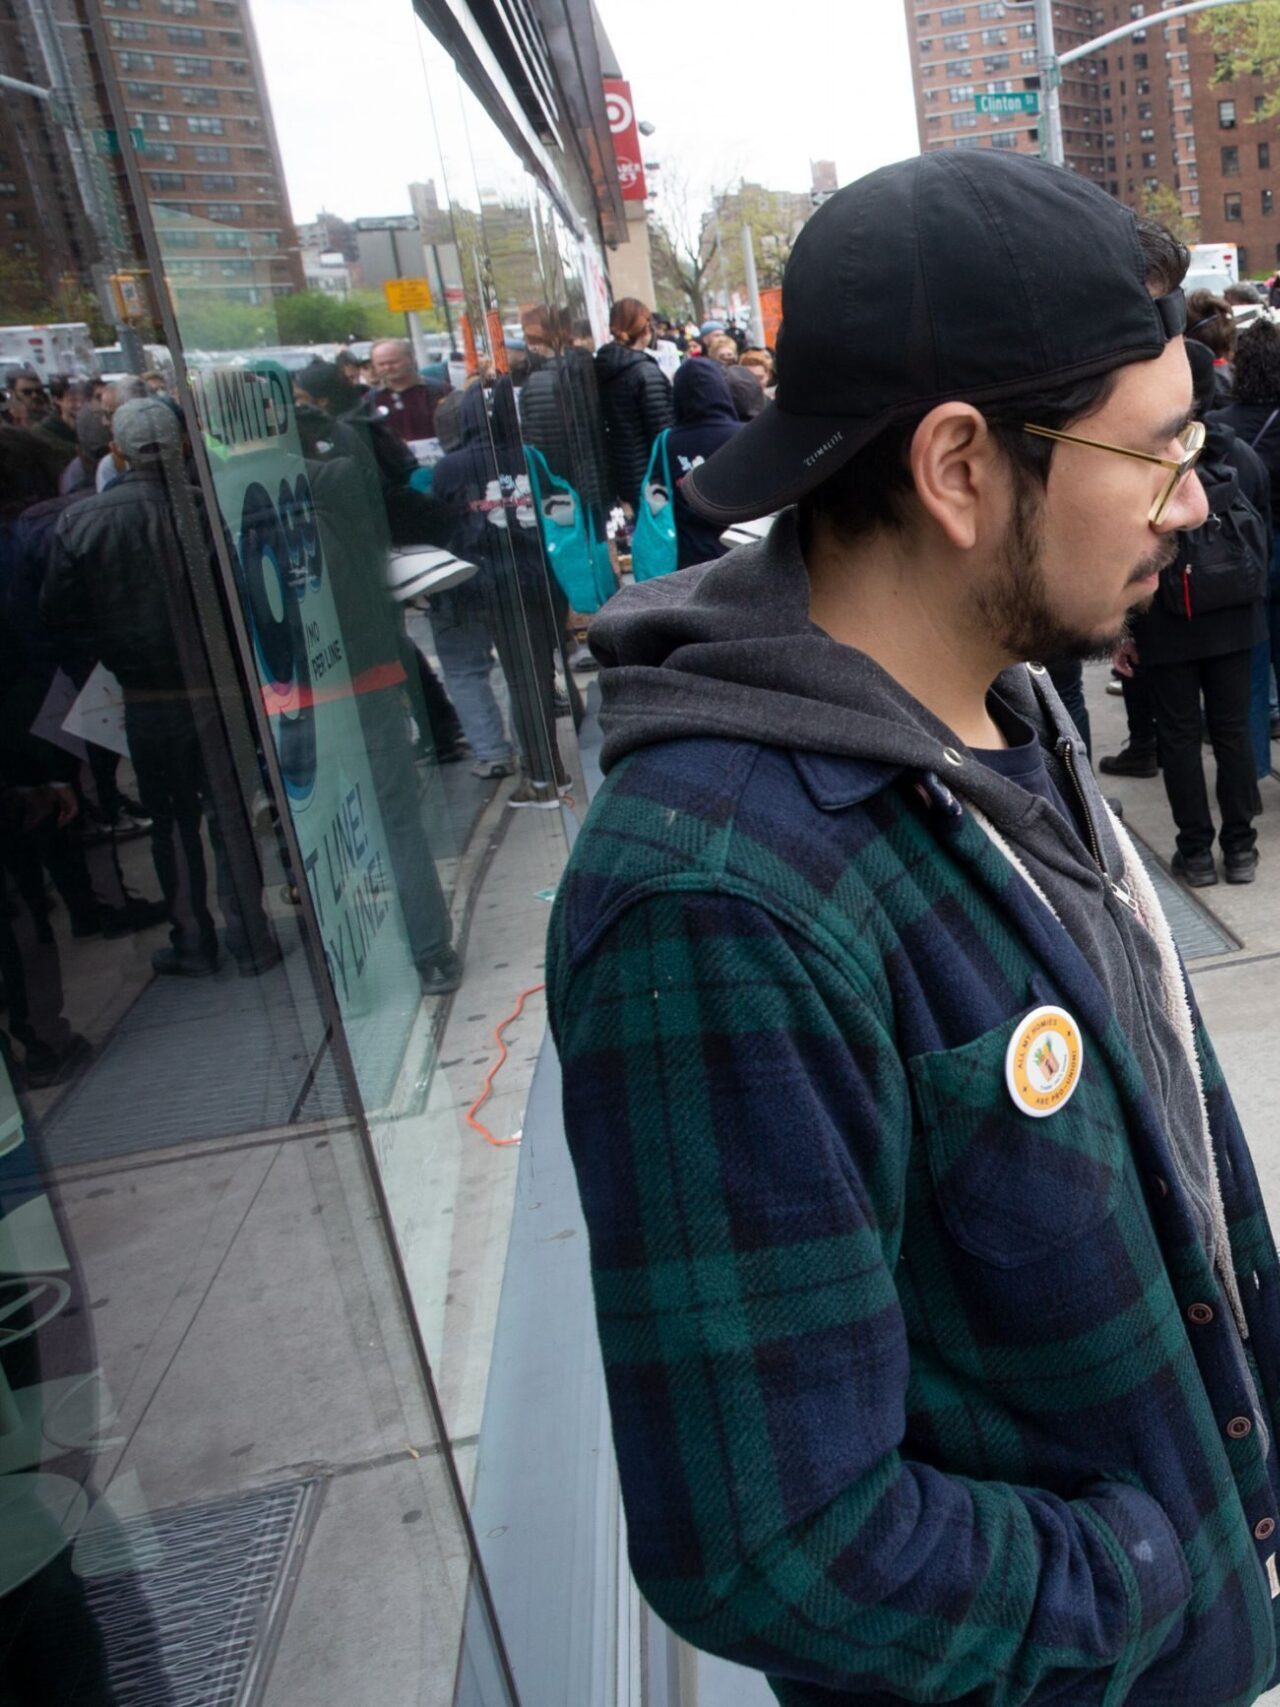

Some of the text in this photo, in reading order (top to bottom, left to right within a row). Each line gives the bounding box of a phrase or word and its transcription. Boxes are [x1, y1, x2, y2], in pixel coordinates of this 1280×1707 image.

[981, 95, 1022, 112] Clinton
[190, 369, 289, 446] LIMITED
[312, 640, 342, 681] PER LINE
[324, 783, 369, 904] LINE!
